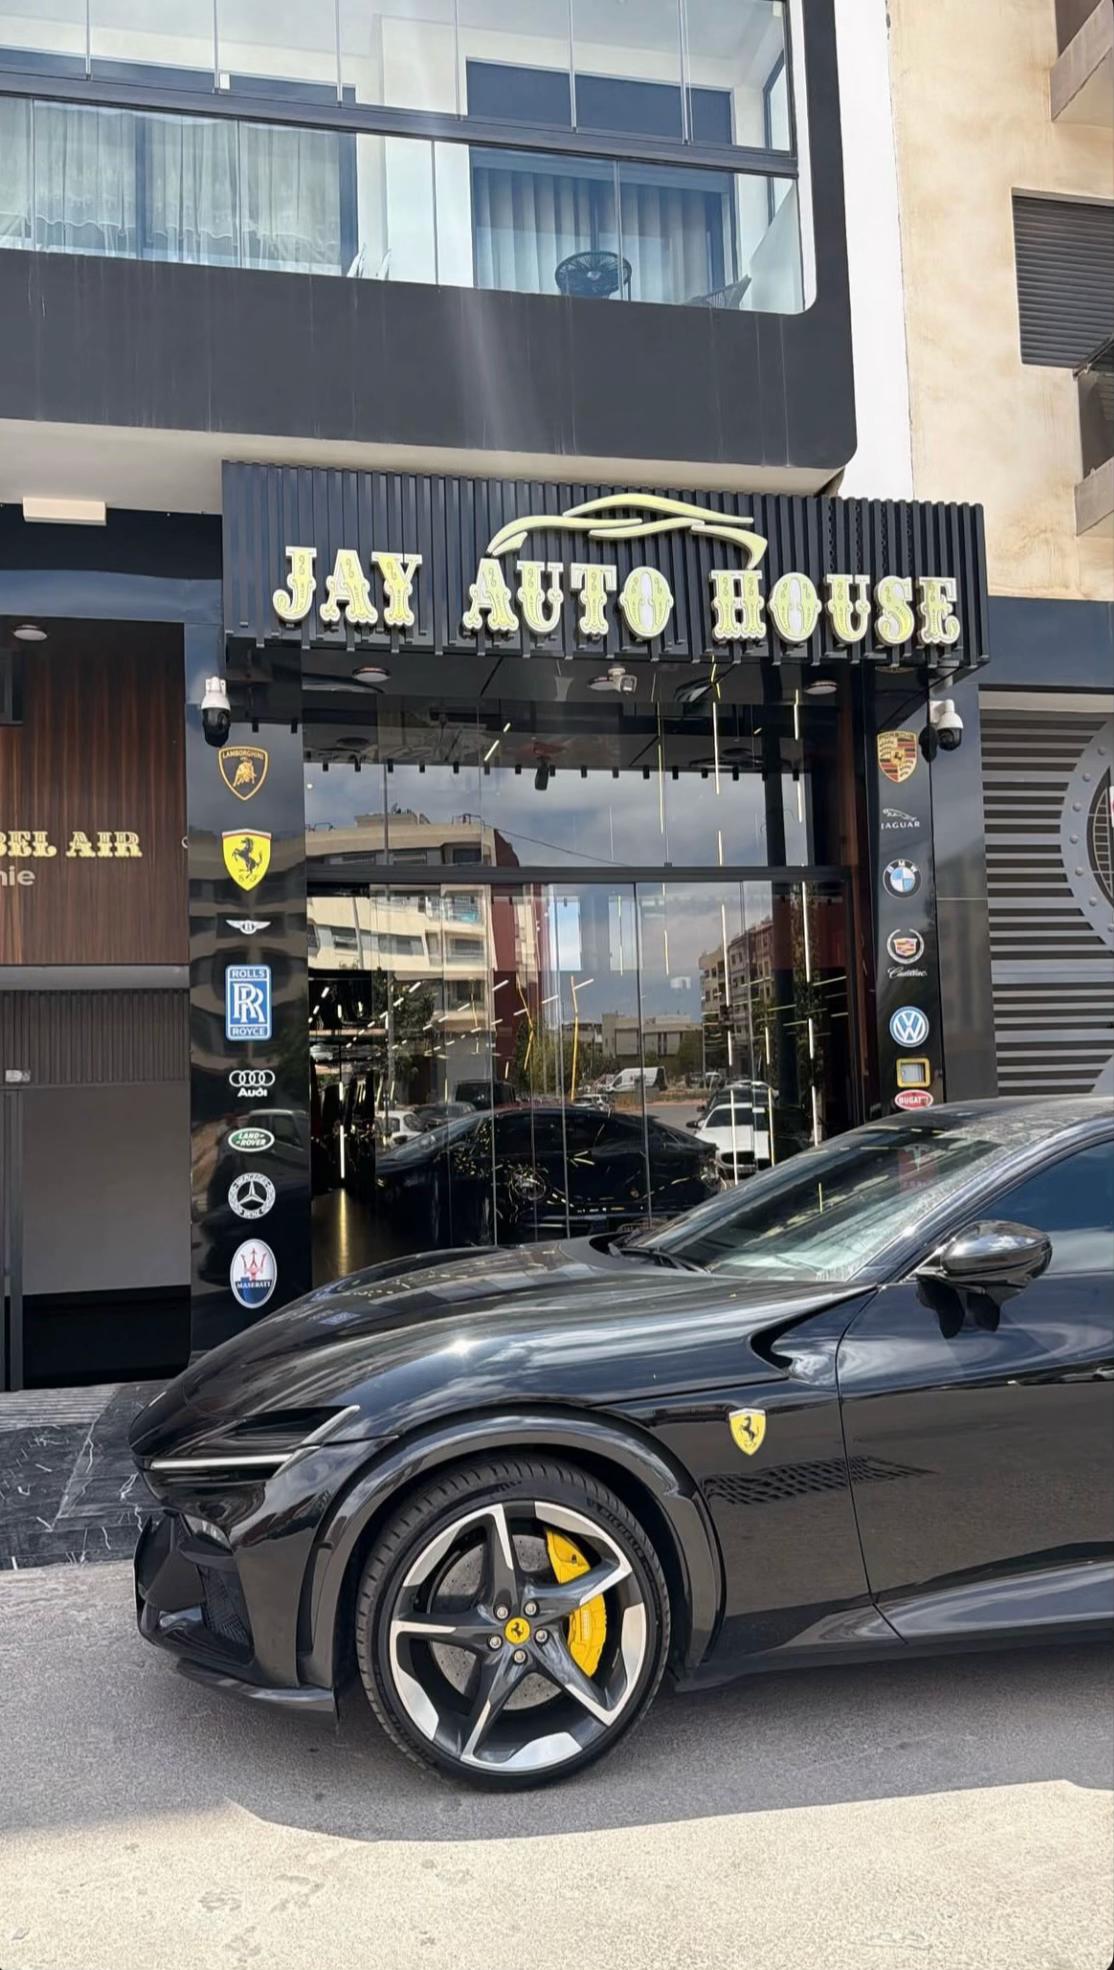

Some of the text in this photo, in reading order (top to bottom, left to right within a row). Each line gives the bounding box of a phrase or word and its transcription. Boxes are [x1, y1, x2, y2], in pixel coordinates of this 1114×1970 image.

[272, 546, 961, 646] JAY AUTO HOUSE
[881, 821, 920, 830] JAGUAR
[66, 831, 143, 857] AIR
[232, 969, 265, 978] ROLLS
[232, 1027, 265, 1036] ROYCE
[237, 1087, 268, 1097] Audi
